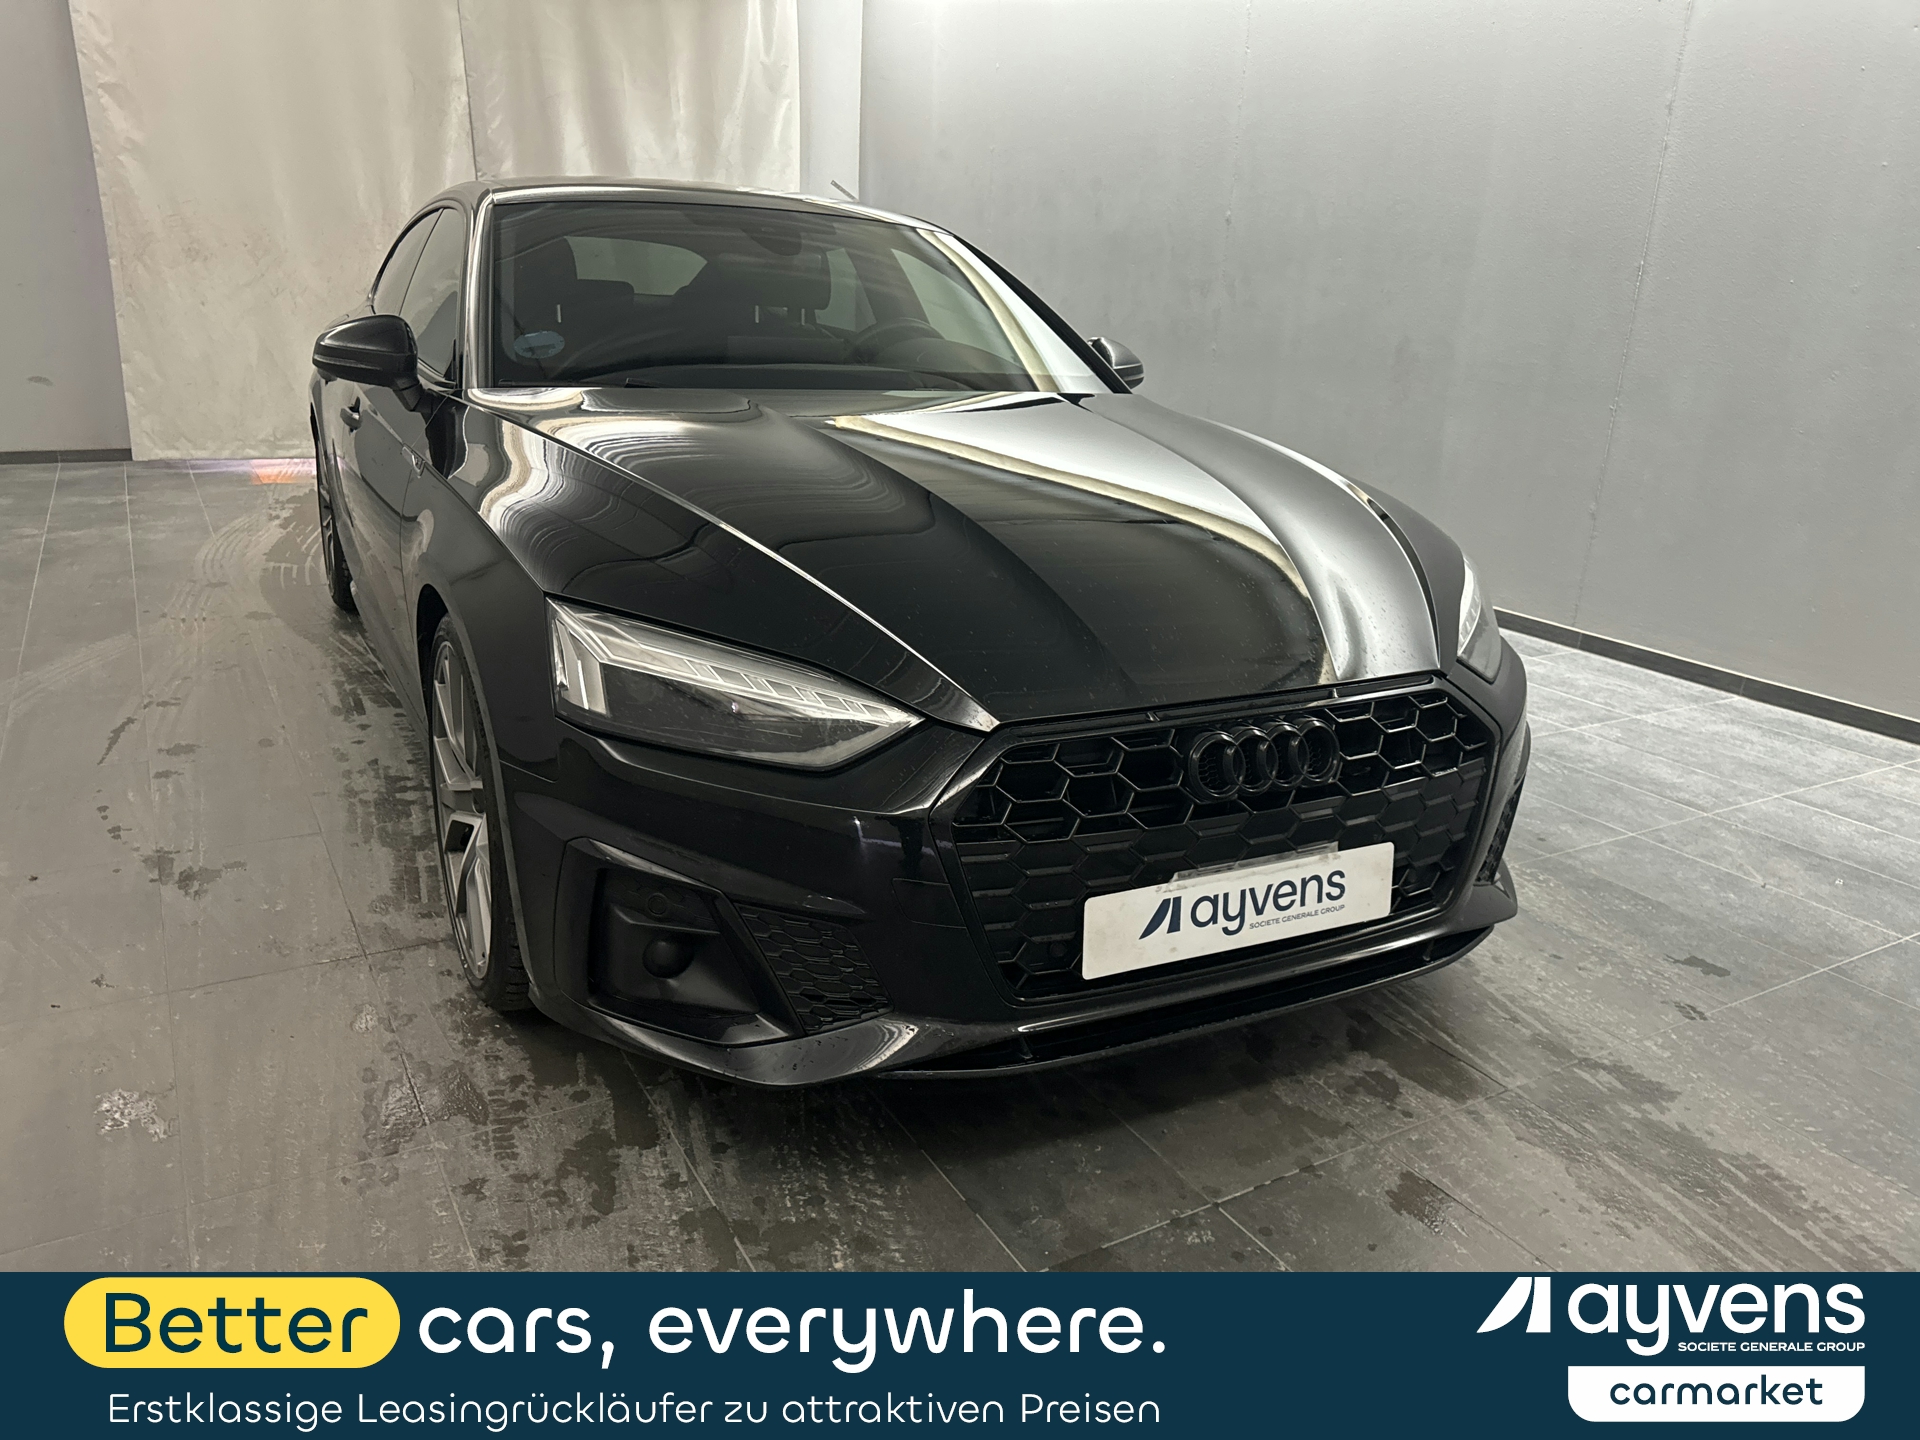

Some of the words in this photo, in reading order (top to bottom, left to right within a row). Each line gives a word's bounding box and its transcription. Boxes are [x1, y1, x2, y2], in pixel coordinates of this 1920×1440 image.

[1191, 870, 1346, 936] ayvens
[1249, 916, 1281, 930] SOCIETE
[1281, 909, 1320, 924] GENERALE
[1320, 903, 1346, 916] GROUP
